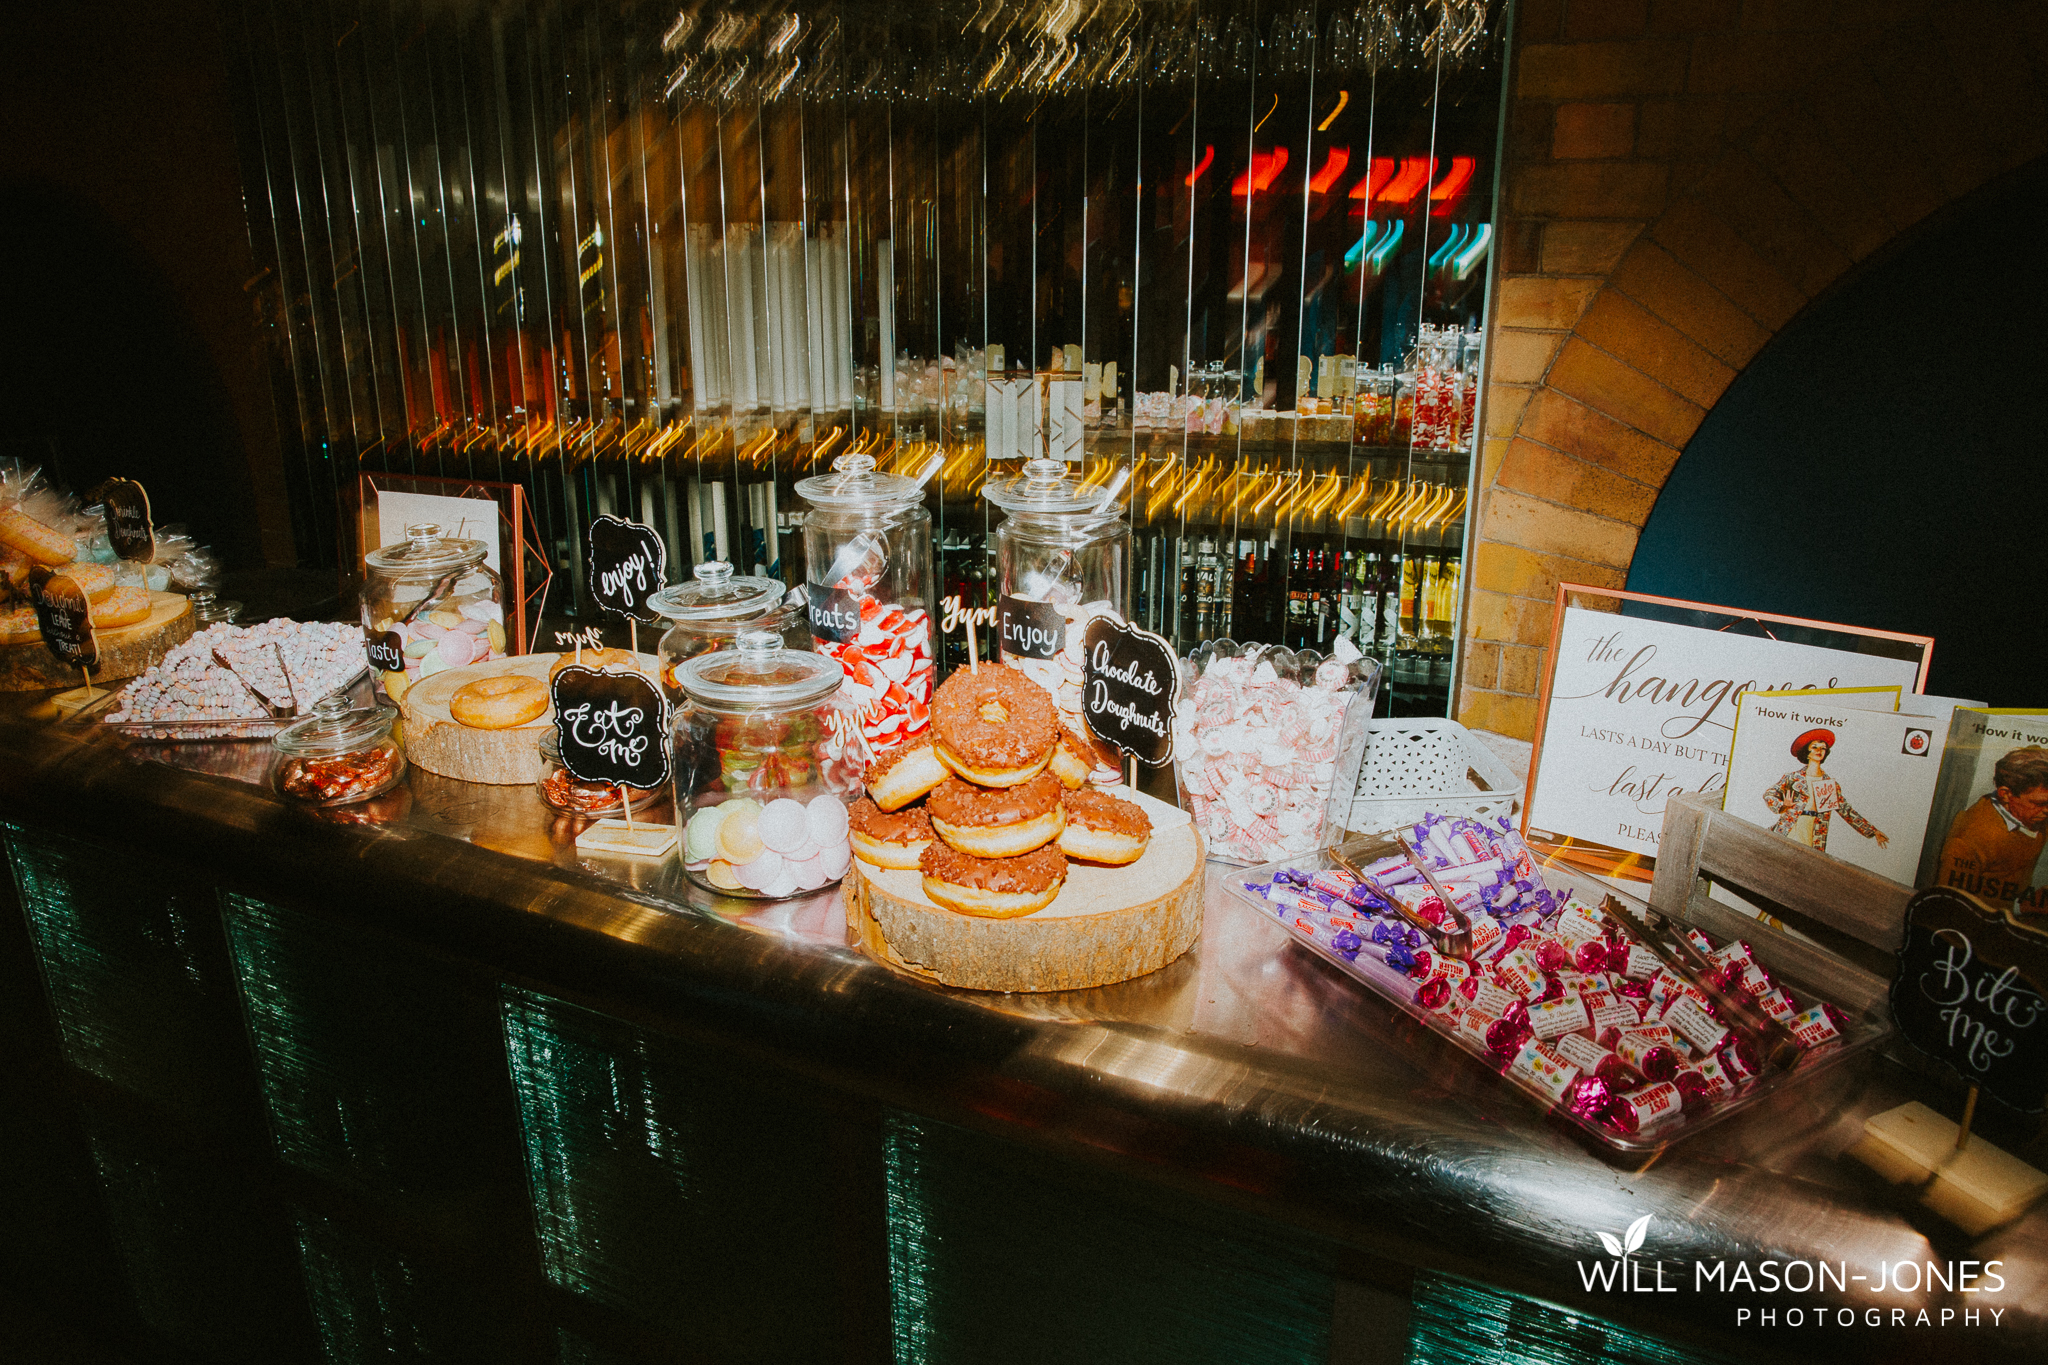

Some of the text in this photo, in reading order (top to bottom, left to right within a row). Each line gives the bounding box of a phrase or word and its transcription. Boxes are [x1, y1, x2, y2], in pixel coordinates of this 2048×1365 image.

[56, 638, 83, 657] TREAT!
[1003, 611, 1058, 656] Enjoy
[1583, 631, 1630, 663] the
[366, 638, 400, 671] Tasty
[1092, 640, 1162, 696] Chocolate
[1090, 679, 1167, 738] Doughnuts
[1790, 711, 1800, 721] it
[564, 700, 644, 748] Eat
[2011, 730, 2022, 740] it
[1581, 725, 1625, 745] LASTS
[1627, 736, 1637, 748] A
[1641, 738, 1672, 755] DAY
[1674, 744, 1708, 762] BUT
[1954, 857, 1977, 870] THE
[1469, 927, 1499, 949] MARRIED
[1471, 924, 1489, 937] JUST
[1920, 928, 2047, 1028] Bite
[1633, 1081, 1673, 1106] MARRIED
[1649, 1096, 1669, 1114] JUST
